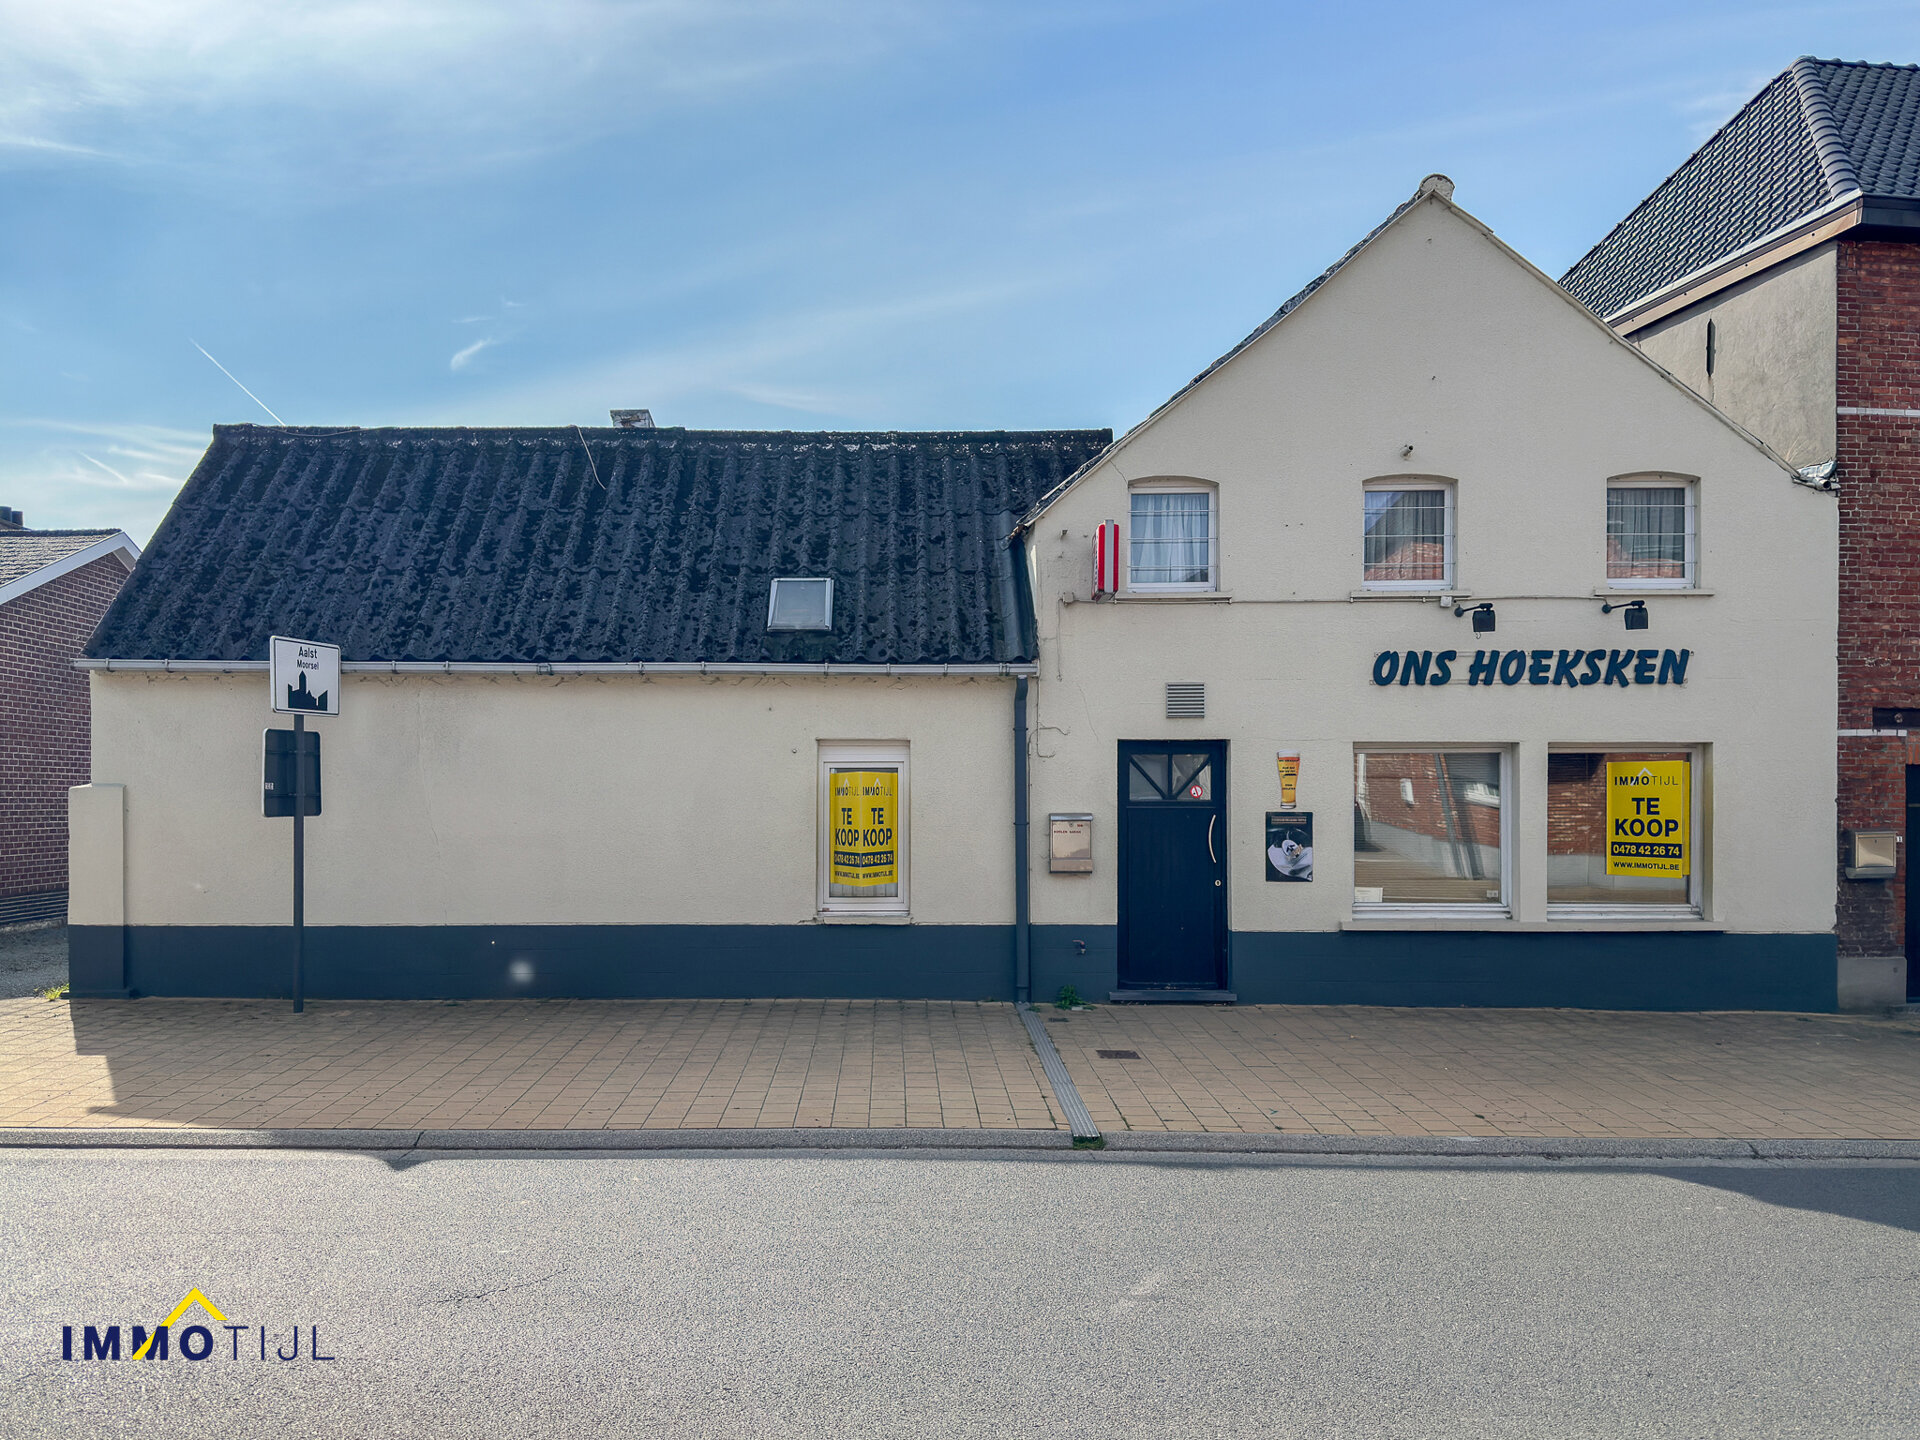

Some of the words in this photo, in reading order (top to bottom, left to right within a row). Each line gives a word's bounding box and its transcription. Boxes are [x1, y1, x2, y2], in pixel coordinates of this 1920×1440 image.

[298, 646, 318, 660] Aalst
[297, 660, 320, 670] Moorsel
[1372, 650, 1457, 687] ONS
[1468, 648, 1690, 688] HOEKSKEN
[1614, 775, 1679, 786] IMMOTIJL
[1631, 797, 1660, 815] TE
[841, 807, 853, 825] TE
[870, 807, 885, 825] TE
[1614, 818, 1679, 838] KOOP
[835, 828, 860, 847] KOOP
[862, 828, 893, 847] KOOP
[1613, 844, 1637, 855] 0478
[1638, 845, 1651, 855] 42
[1653, 845, 1666, 856] 26
[1667, 845, 1680, 856] 74
[862, 854, 874, 866] 0478
[1613, 861, 1680, 871] WWW.IMMOTIJL.BE
